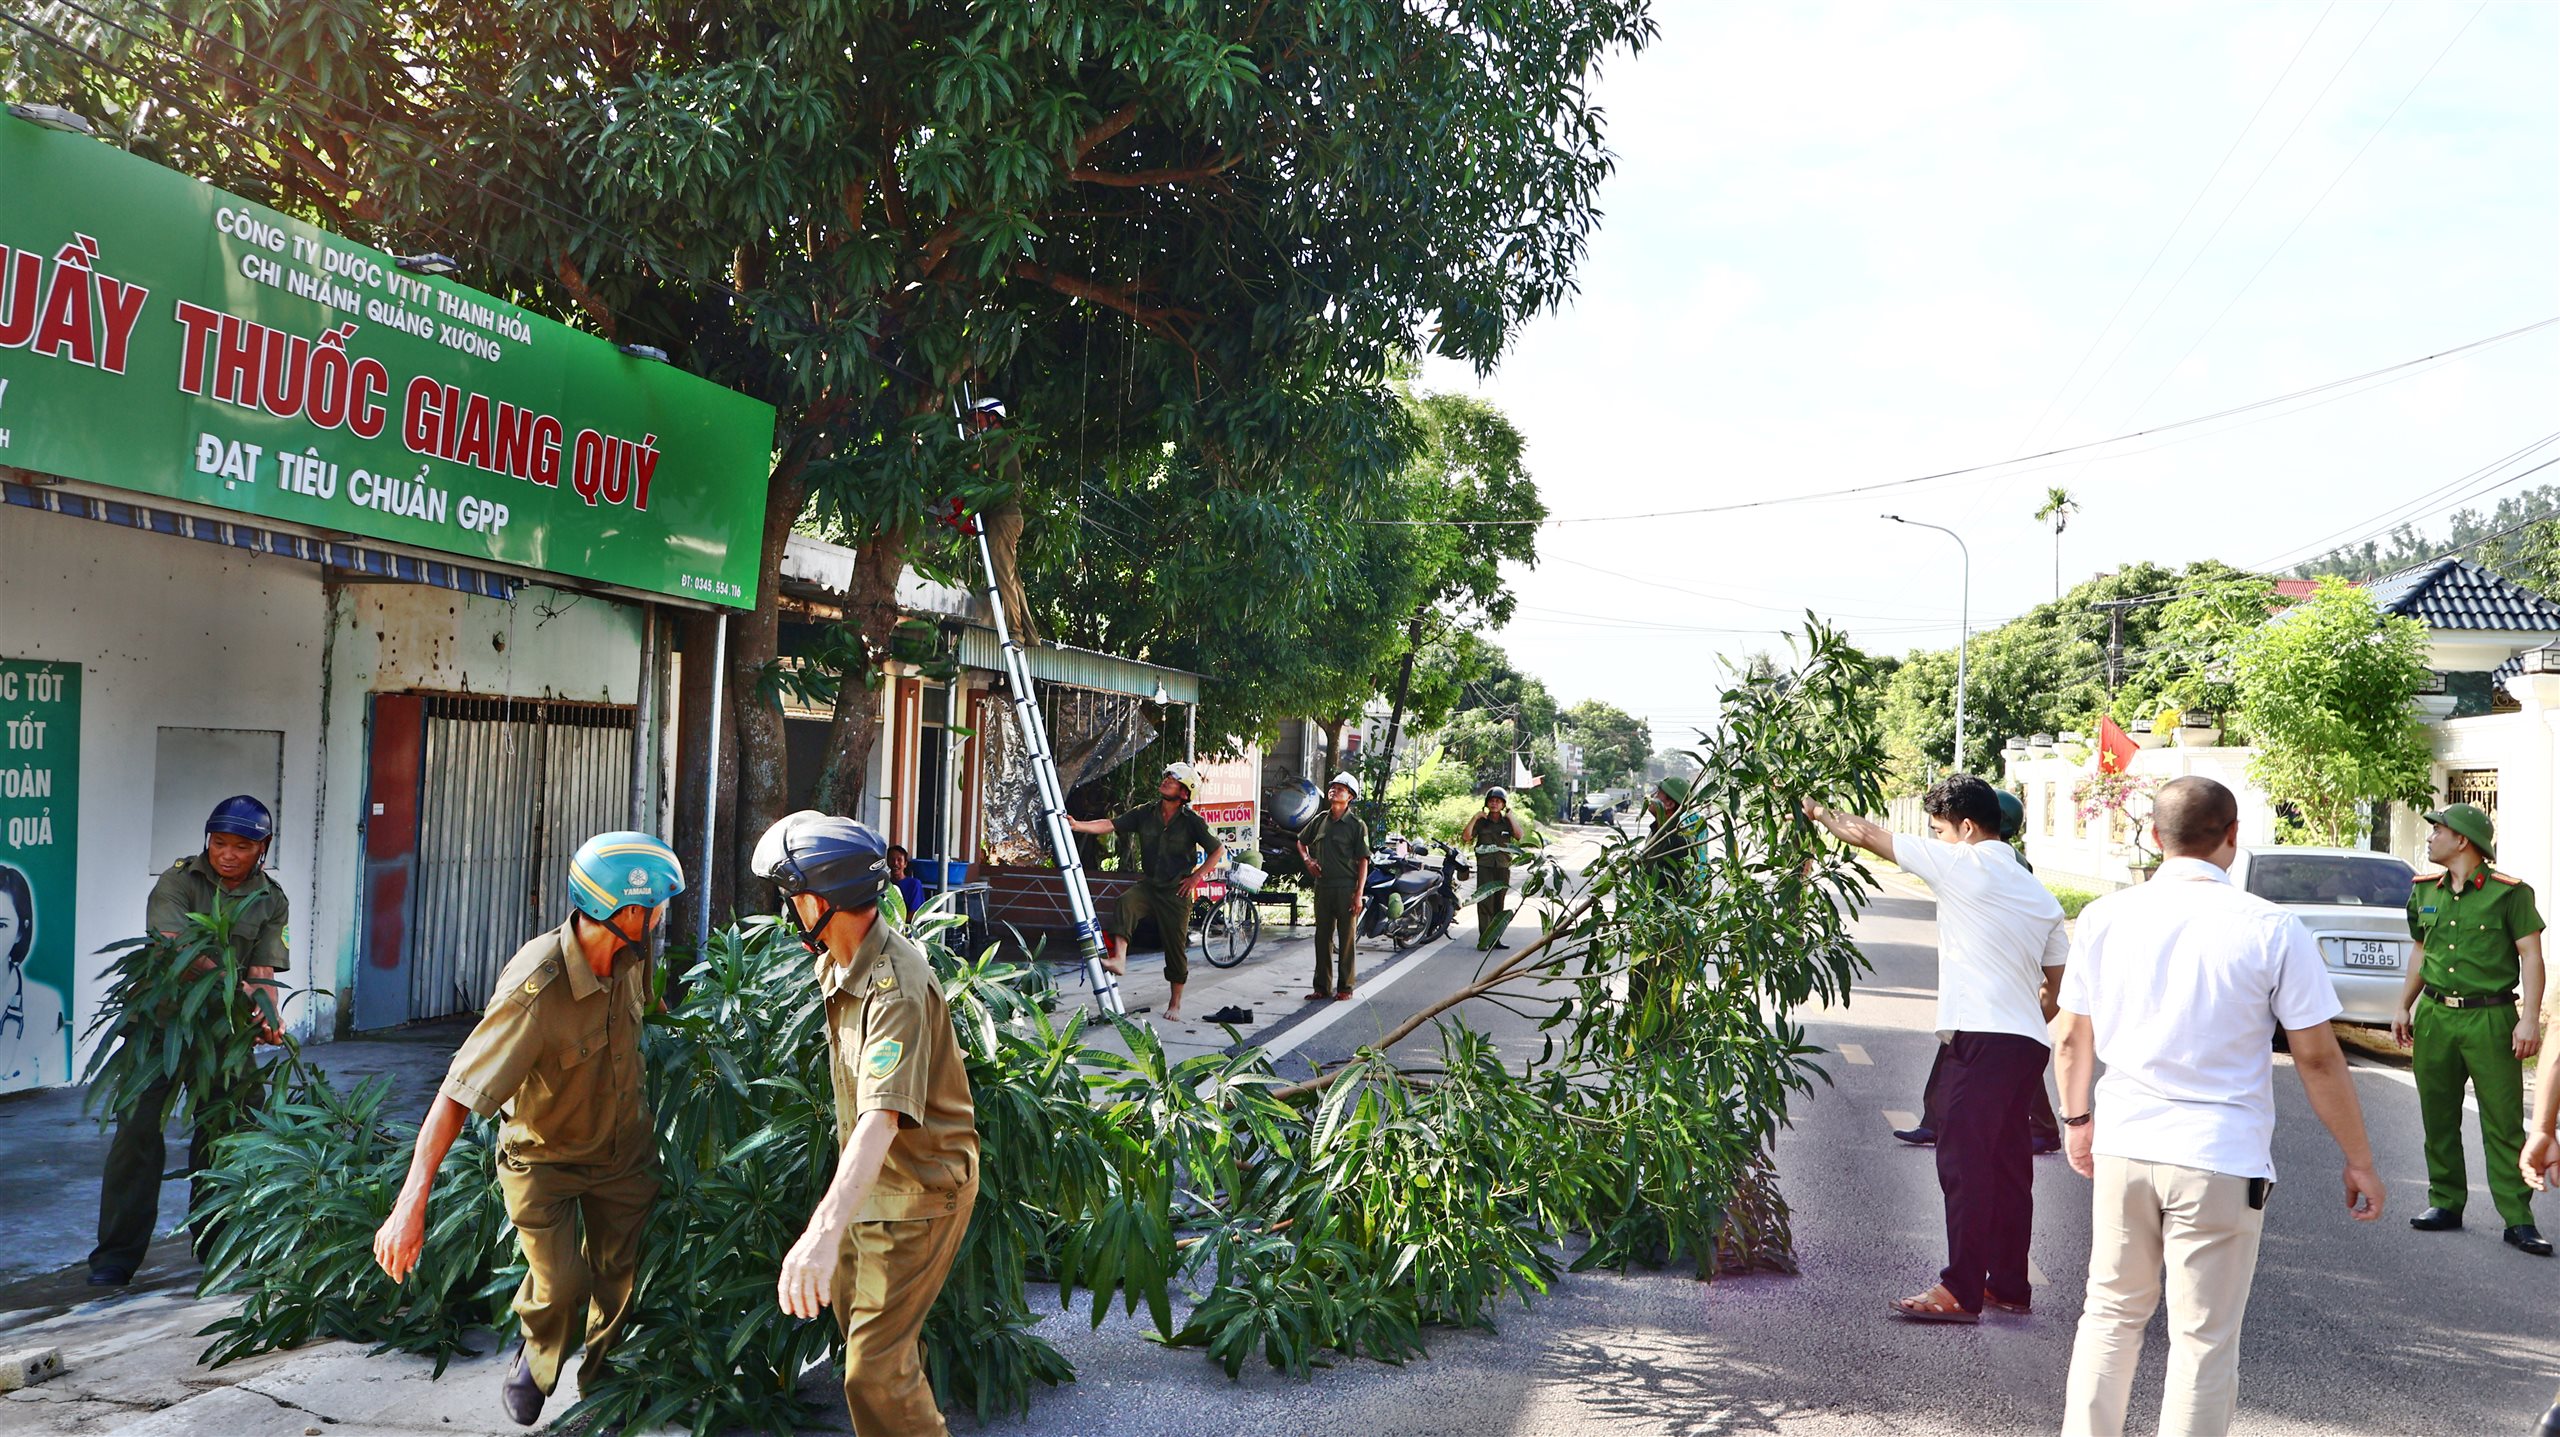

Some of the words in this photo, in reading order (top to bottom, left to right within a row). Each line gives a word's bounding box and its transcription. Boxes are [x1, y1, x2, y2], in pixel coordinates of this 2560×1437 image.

[216, 207, 285, 252] CÔNG
[292, 234, 318, 264] TY
[322, 247, 382, 288] DƯỢC
[386, 271, 432, 307] VTYT
[437, 290, 494, 331] THANH
[496, 312, 531, 345] HÓA
[240, 254, 282, 288] CHI
[287, 274, 361, 316] NHÁNH
[366, 299, 434, 340] QUẢNG
[438, 323, 501, 362] XƯƠNG
[0, 232, 149, 375] UẦY
[175, 300, 389, 440] THUỐC
[402, 376, 563, 488] GIANG
[572, 429, 661, 512] QUÝ
[195, 432, 262, 490] ĐẠT
[277, 447, 338, 499] TIÊU
[348, 464, 448, 523] CHUẨN
[457, 495, 509, 535] GPP
[25, 664, 64, 702] TỐT
[7, 710, 46, 749] TỐT
[8, 807, 53, 849] QUẢ
[1223, 803, 1251, 822] CUỐN
[624, 887, 652, 896] YAMAHA
[2352, 952, 2394, 966] 709.85
[2361, 941, 2384, 954] 36A
